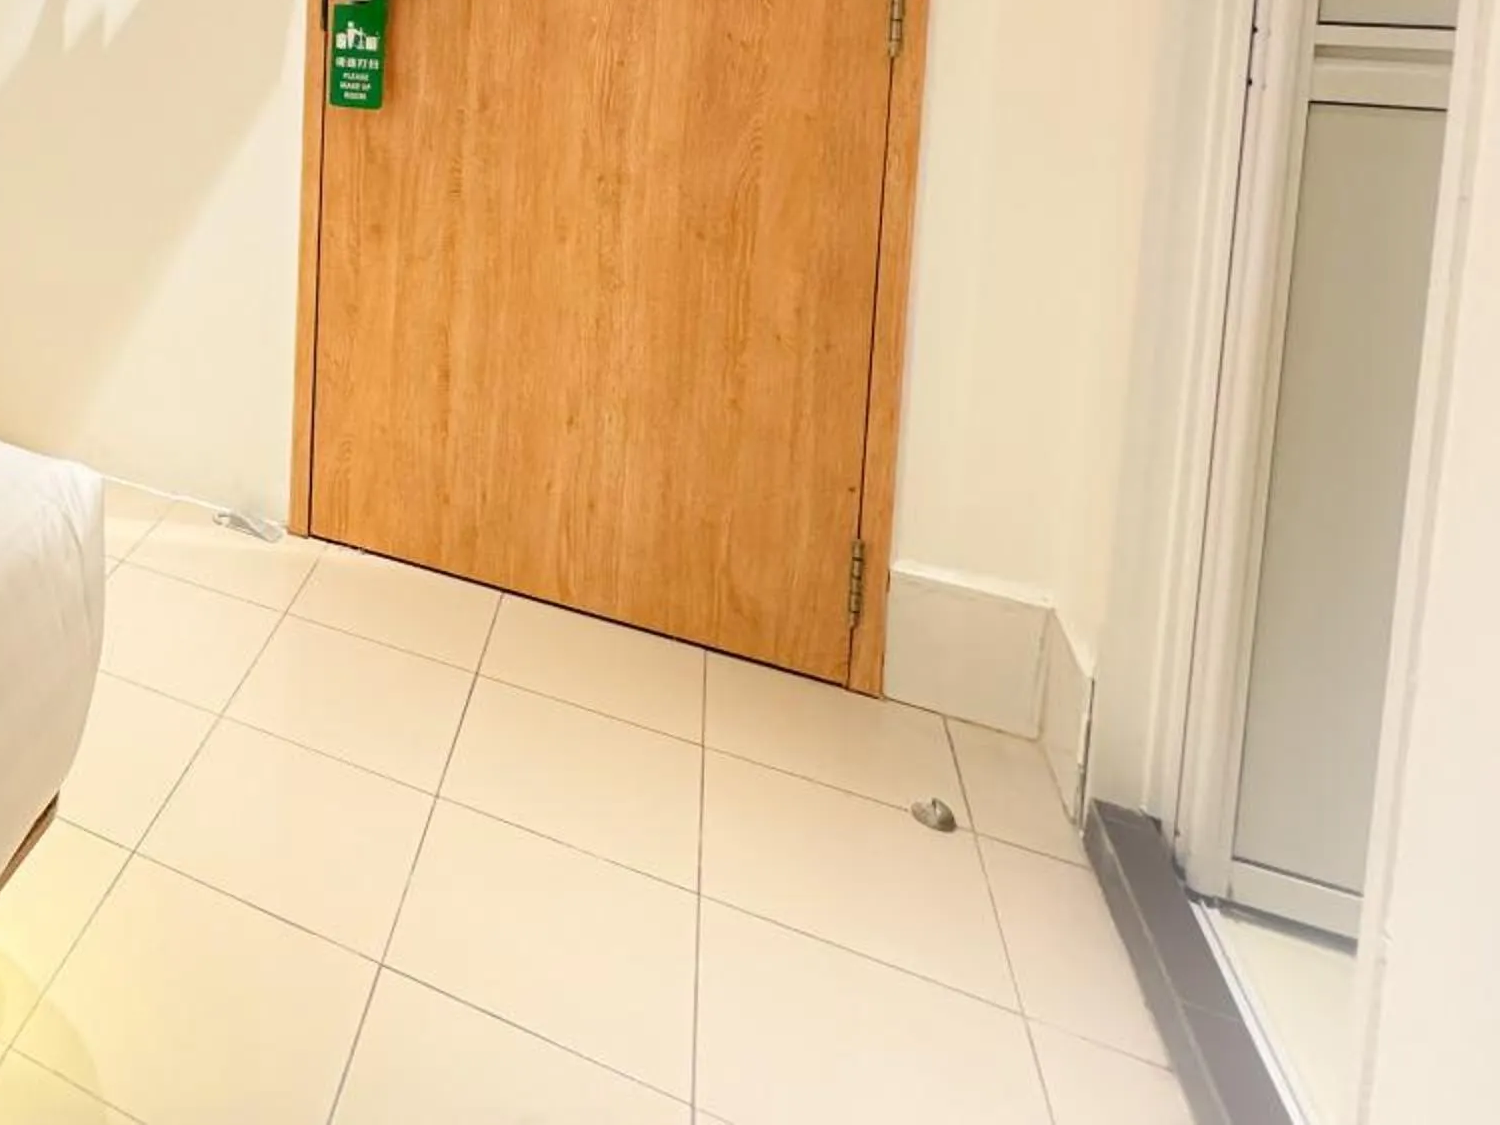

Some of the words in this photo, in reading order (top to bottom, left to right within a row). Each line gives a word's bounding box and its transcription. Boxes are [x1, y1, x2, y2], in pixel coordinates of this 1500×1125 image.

[343, 72, 369, 81] PLEASE
[340, 81, 360, 90] MAKE
[361, 82, 371, 91] UP
[343, 91, 367, 100] ROOM
